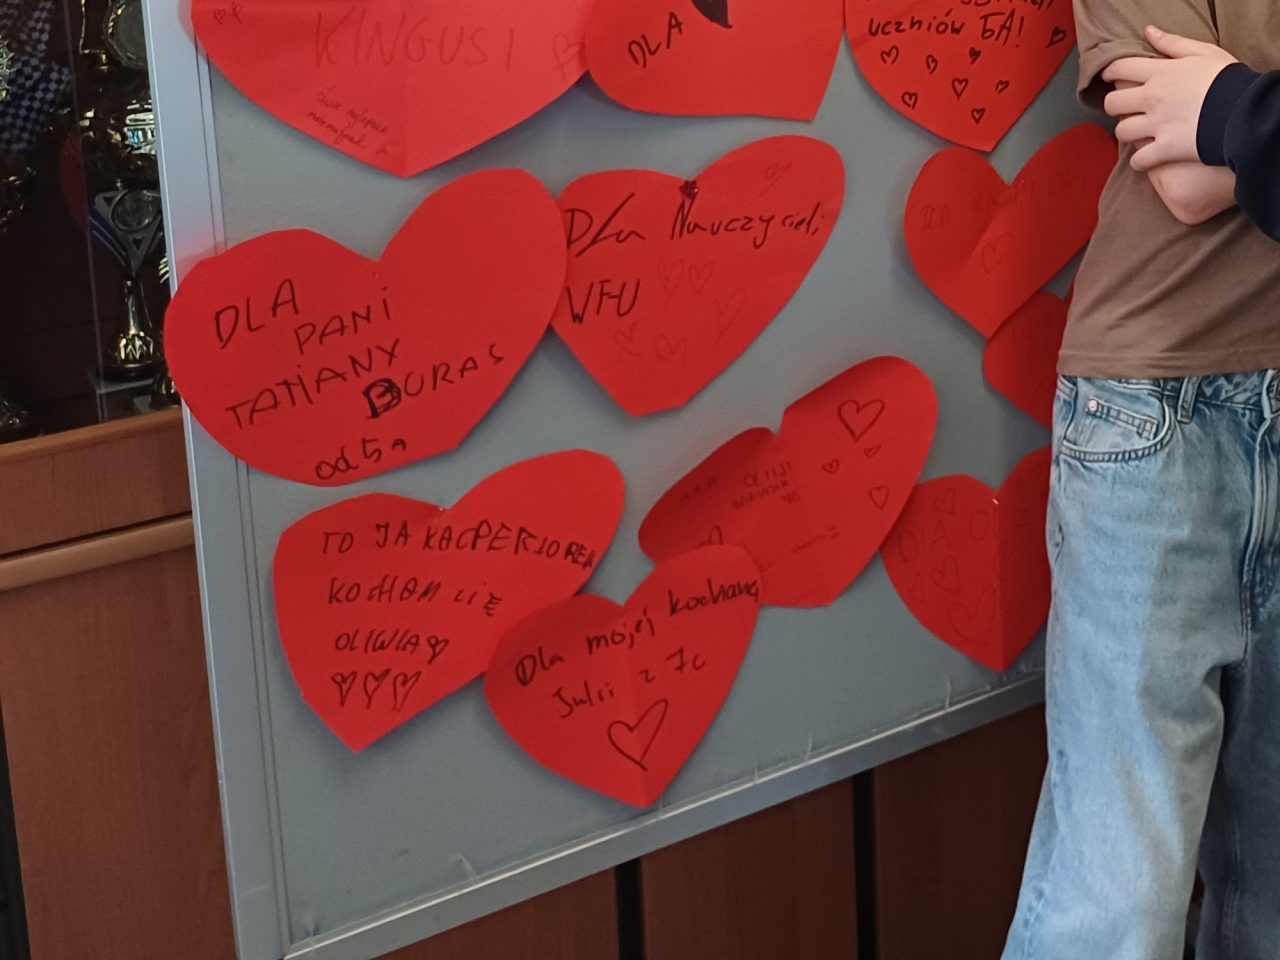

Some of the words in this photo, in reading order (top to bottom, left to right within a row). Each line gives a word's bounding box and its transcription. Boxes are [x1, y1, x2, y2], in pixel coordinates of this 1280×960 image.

[628, 11, 684, 68] DLA
[215, 278, 300, 350] DLA
[323, 531, 355, 554] TO
[375, 520, 410, 548] JA
[515, 646, 565, 686] Dla
